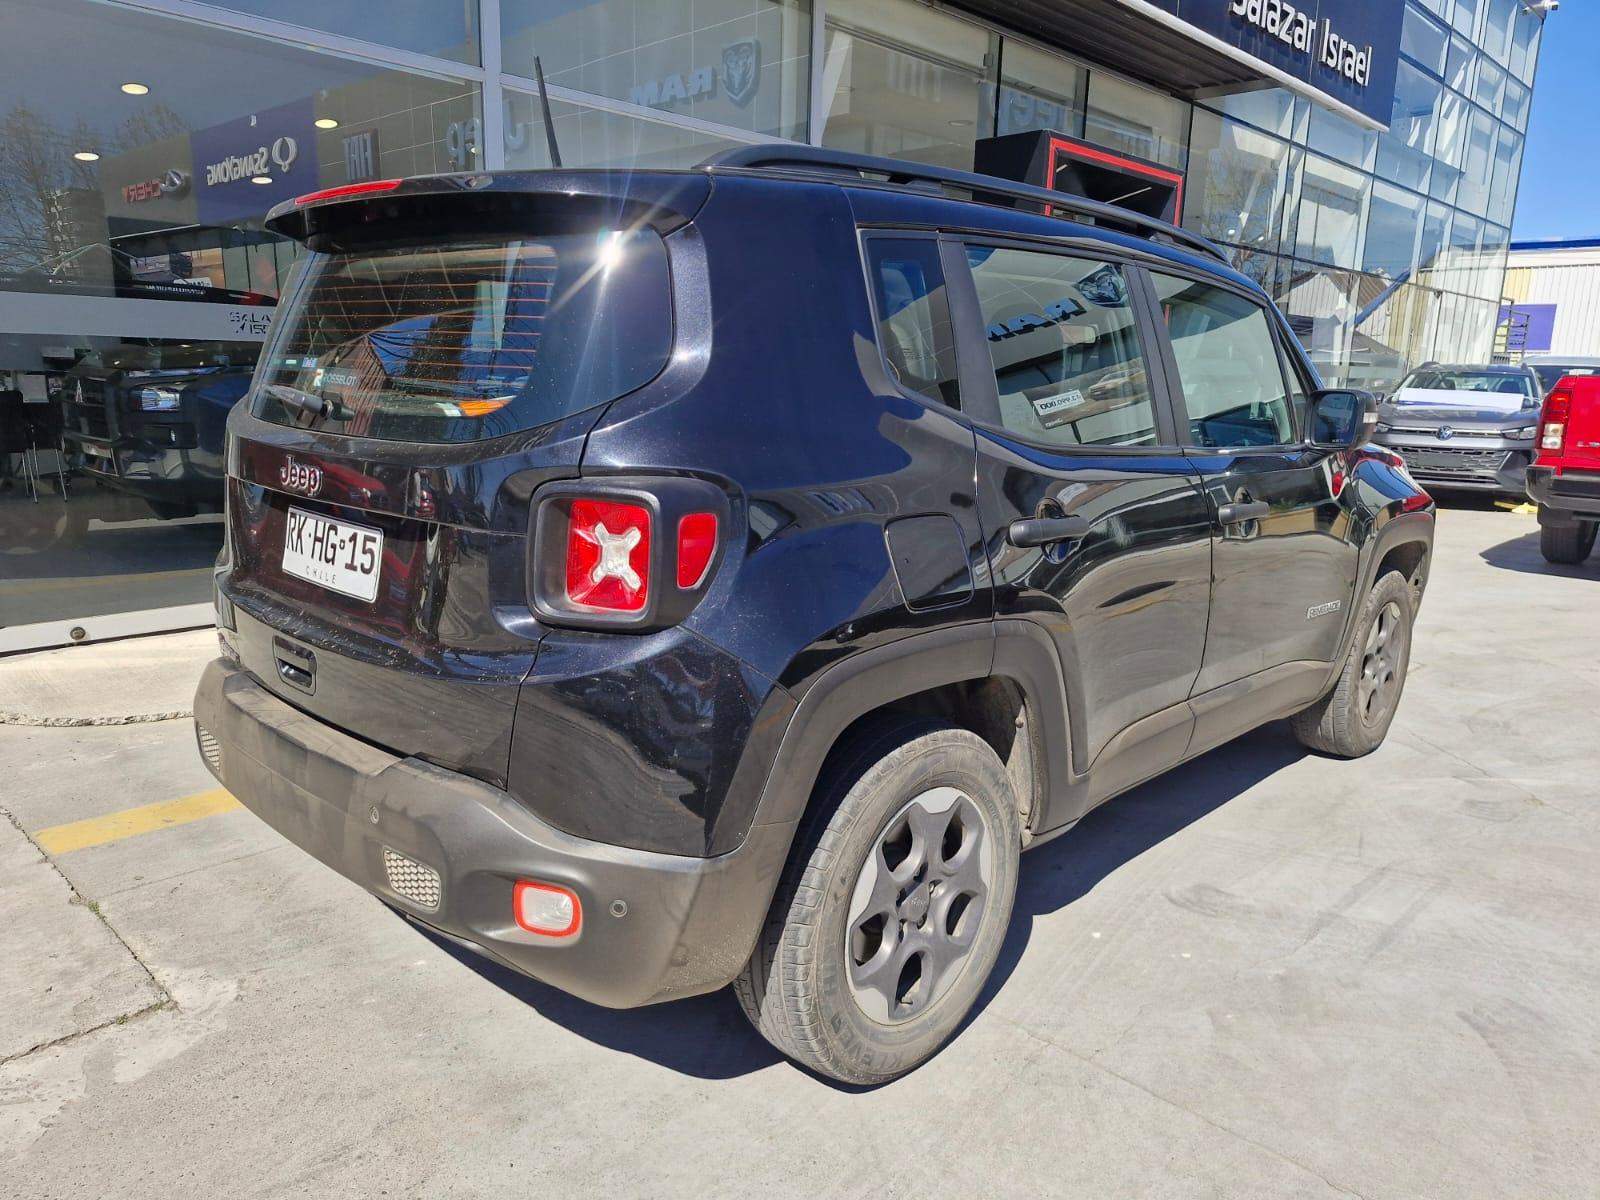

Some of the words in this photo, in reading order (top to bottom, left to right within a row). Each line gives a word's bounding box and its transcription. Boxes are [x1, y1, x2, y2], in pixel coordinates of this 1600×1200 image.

[1319, 18, 1373, 87] Israel
[280, 454, 324, 497] Jeep
[305, 565, 337, 585] CHILE
